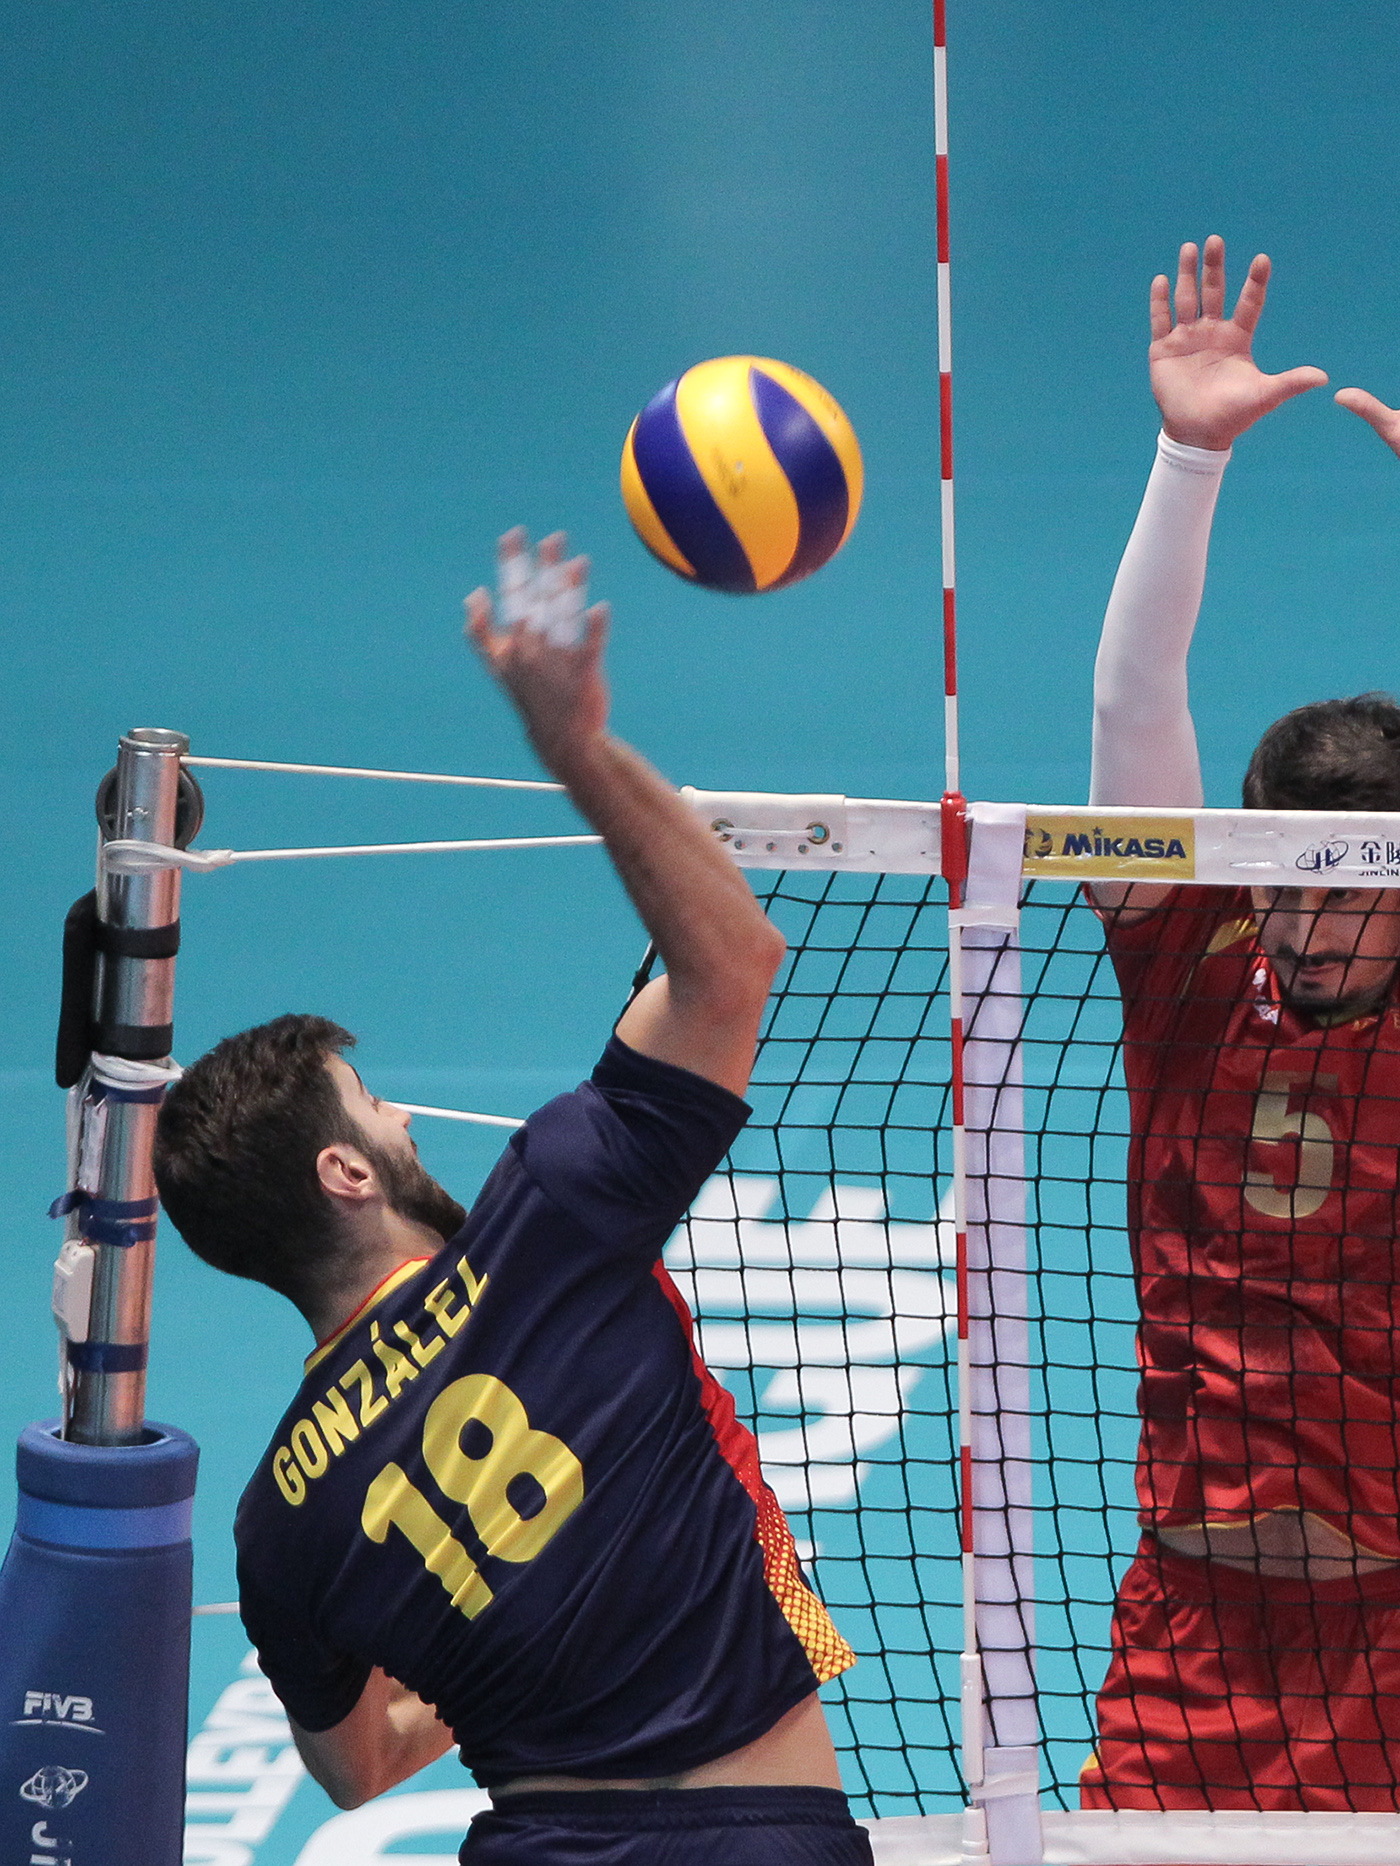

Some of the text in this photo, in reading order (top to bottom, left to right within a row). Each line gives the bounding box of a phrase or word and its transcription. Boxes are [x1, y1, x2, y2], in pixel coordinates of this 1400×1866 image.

[1242, 1070, 1339, 1219] 5
[272, 1254, 489, 1506] GONZÁLEZ
[361, 1373, 585, 1621] 18
[23, 1690, 95, 1722] FIVB
